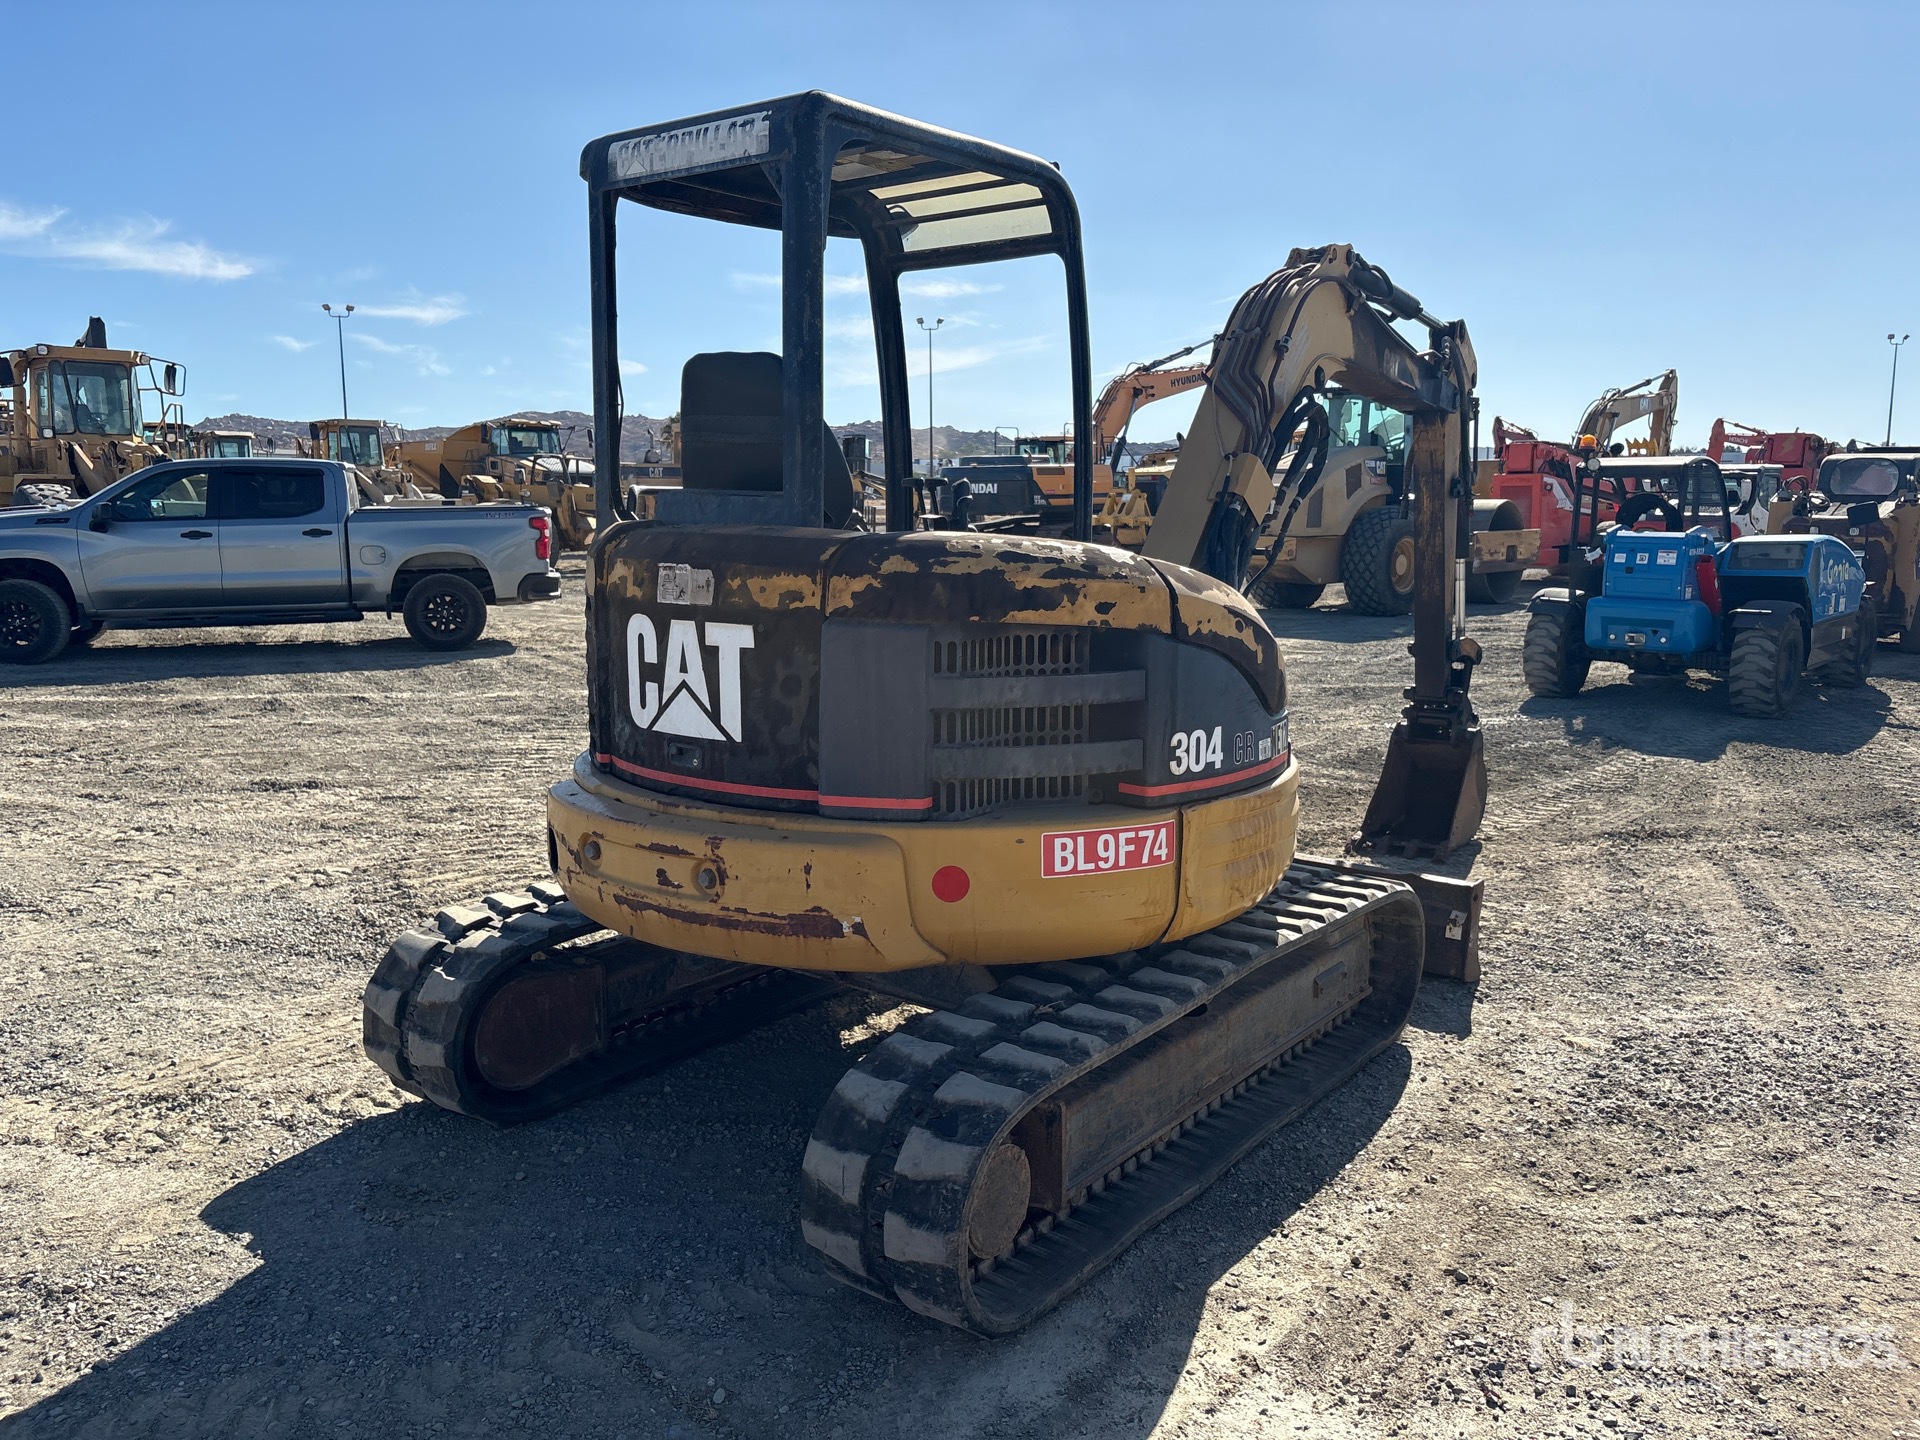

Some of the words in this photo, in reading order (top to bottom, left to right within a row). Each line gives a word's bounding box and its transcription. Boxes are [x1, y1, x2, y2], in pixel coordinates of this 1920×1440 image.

[1170, 373, 1203, 388] HYUNDA
[1728, 436, 1748, 445] HITACHI
[648, 467, 664, 478] CAT
[1376, 460, 1386, 475] CAT
[1827, 558, 1849, 585] Genie
[627, 613, 755, 743] CAT
[1169, 726, 1223, 777] 304
[1233, 730, 1255, 765] CR
[1053, 827, 1168, 873] BL9F74
